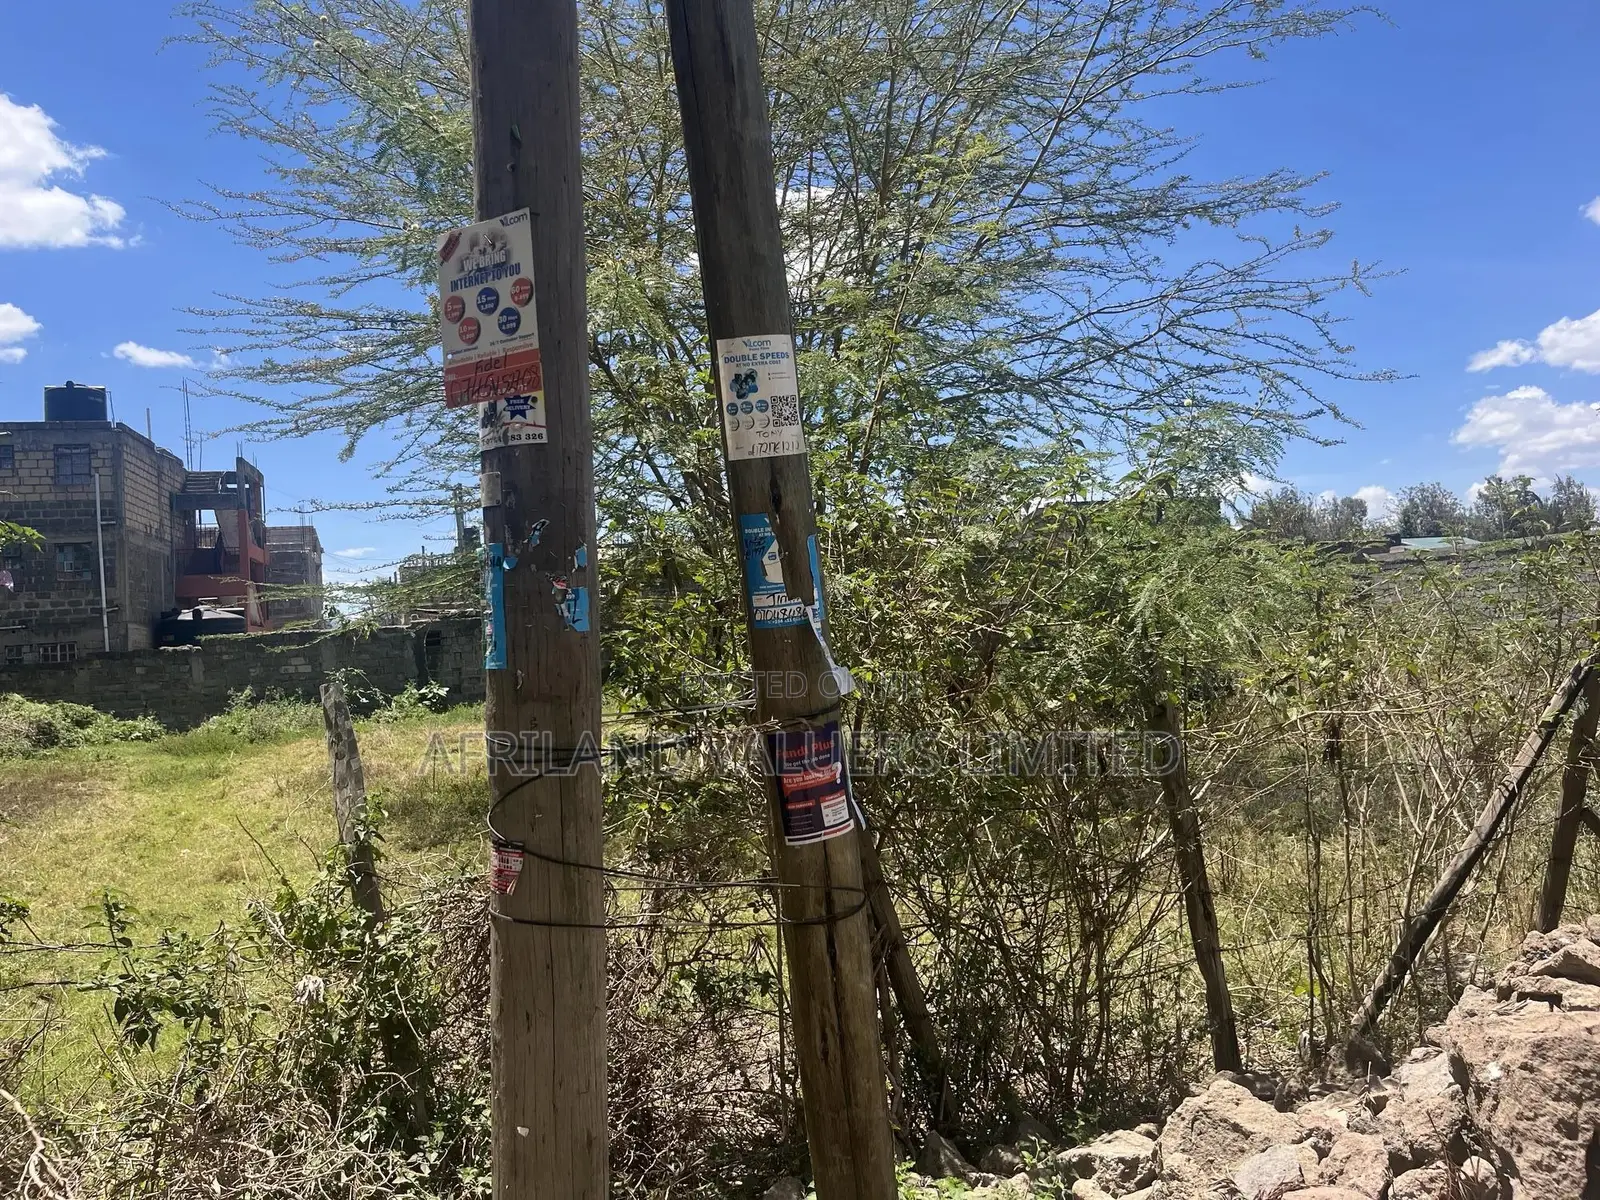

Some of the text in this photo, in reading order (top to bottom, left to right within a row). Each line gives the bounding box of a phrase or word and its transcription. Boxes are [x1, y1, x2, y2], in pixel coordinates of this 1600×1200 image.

[450, 272, 490, 292] INTERNET
[502, 262, 521, 277] YOU
[477, 295, 487, 304] 15
[724, 351, 790, 364] DOUBLE SPEEDS
[525, 433, 544, 441] 326
[813, 740, 835, 752] Plus
[783, 776, 792, 784] Are
